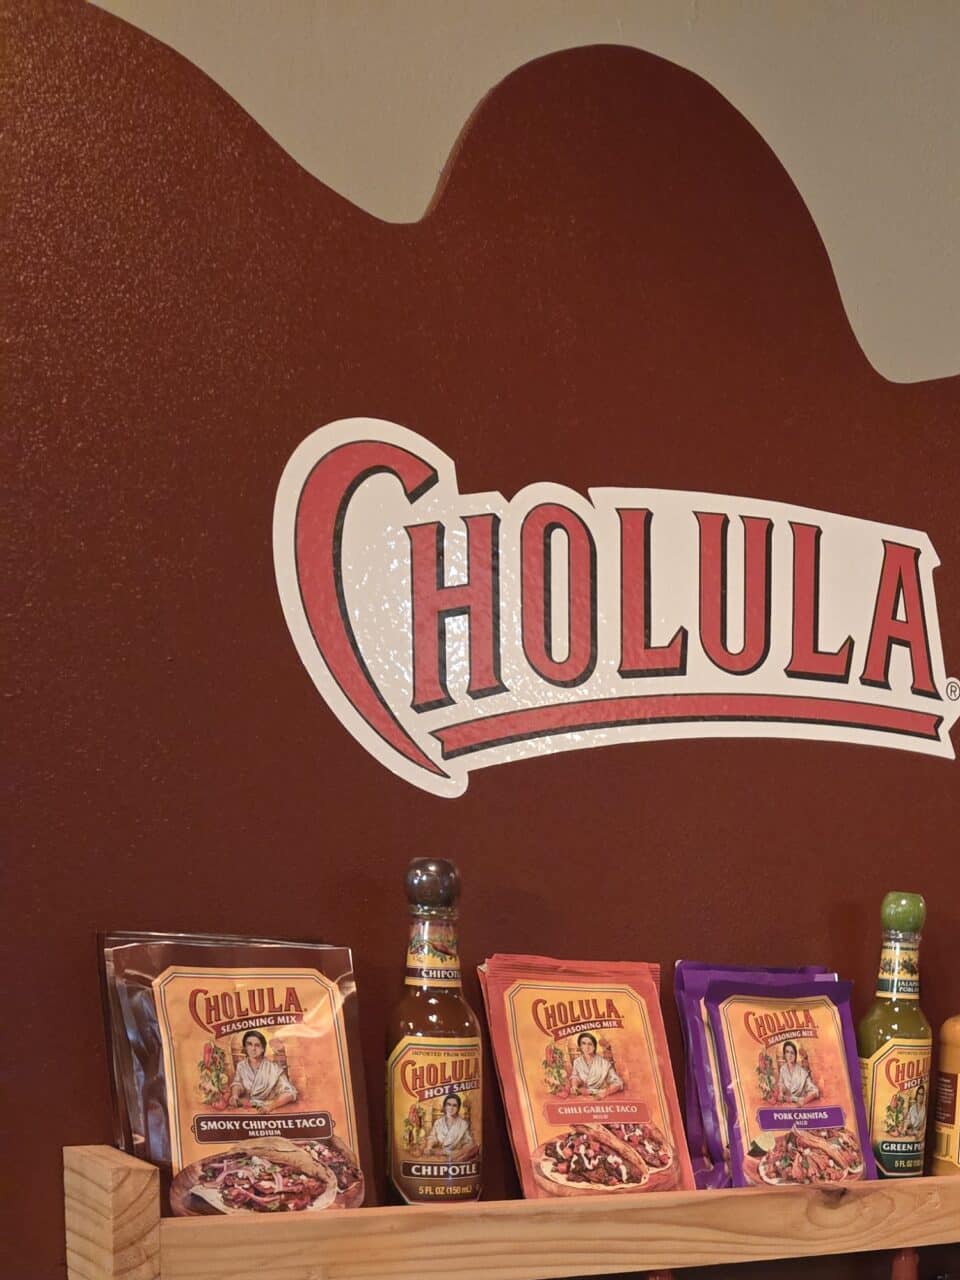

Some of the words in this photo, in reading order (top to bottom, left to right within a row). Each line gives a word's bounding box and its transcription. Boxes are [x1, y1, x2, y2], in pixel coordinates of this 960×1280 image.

[189, 987, 303, 1034] CHOLULA
[220, 1016, 275, 1034] SEASONING
[277, 1014, 296, 1025] MIX
[532, 999, 622, 1037] CHOLULA
[558, 1022, 600, 1036] SEASONING
[744, 1009, 816, 1044] CHOLULA
[904, 1079, 921, 1090] HOT
[424, 1086, 450, 1099] HOT
[558, 1106, 582, 1114] CHILI
[584, 1106, 614, 1114] GARLIC
[616, 1105, 637, 1113] TACO
[773, 1112, 793, 1120] PORK
[794, 1111, 828, 1119] CARNITAS
[200, 1120, 241, 1130] SMOKY
[242, 1119, 294, 1130] CHIPOTLE
[296, 1118, 326, 1128] TACO
[411, 1163, 477, 1176] CHIPOTLE
[419, 1186, 424, 1194] 5
[425, 1186, 433, 1194] FL
